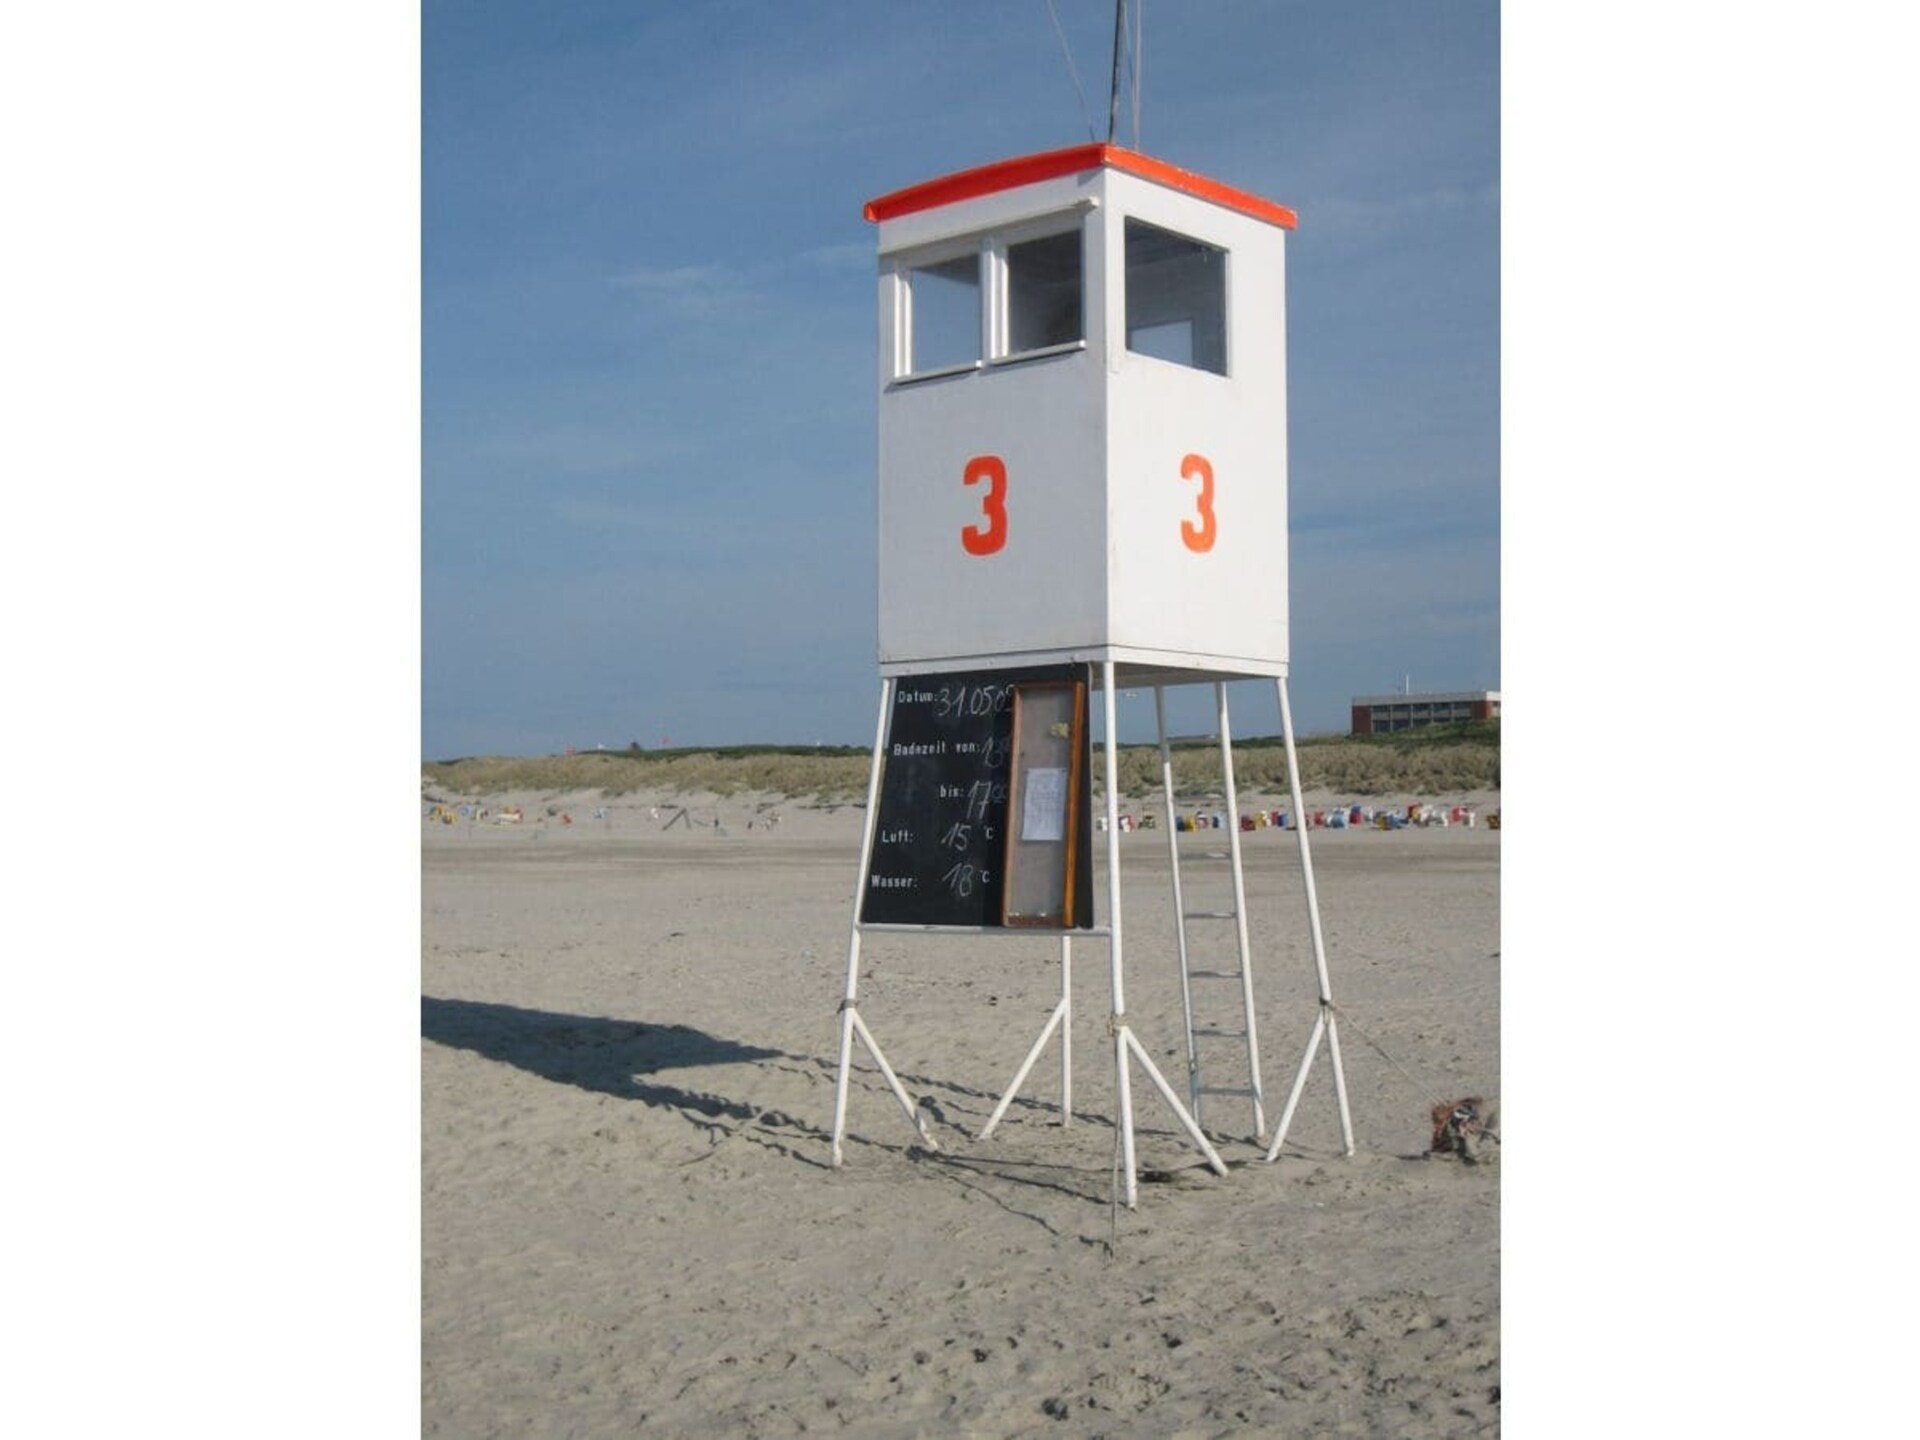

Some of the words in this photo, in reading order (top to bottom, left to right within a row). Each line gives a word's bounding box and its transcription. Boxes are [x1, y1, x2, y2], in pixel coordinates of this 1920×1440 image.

[962, 455, 1008, 556] 3
[1181, 453, 1217, 553] 3
[898, 690, 937, 703] Datum:
[893, 741, 946, 756] Badezeit
[881, 829, 913, 843] Luft:
[941, 822, 971, 851] 15
[871, 874, 918, 888] Wasser:
[942, 862, 974, 897] 18
